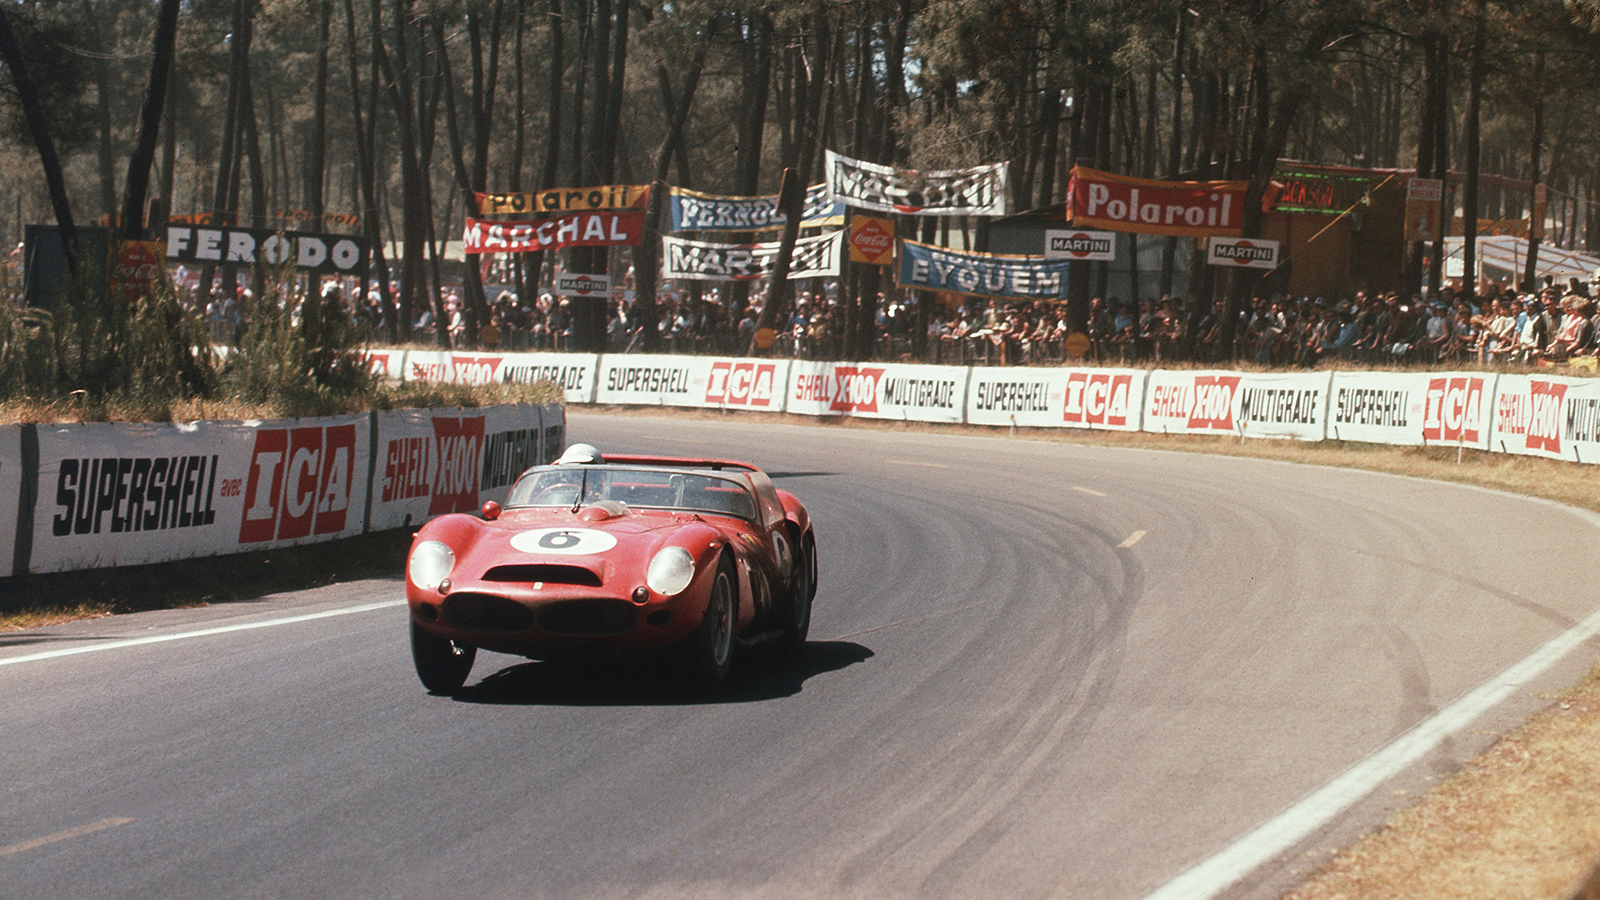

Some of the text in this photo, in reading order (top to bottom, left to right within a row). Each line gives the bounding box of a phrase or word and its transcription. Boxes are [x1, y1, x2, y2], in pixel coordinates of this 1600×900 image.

[1088, 183, 1232, 226] Polaroil
[166, 227, 360, 269] FERODO
[463, 215, 627, 249] MARCHAL
[1053, 239, 1109, 251] MARTINI
[1216, 246, 1271, 260] MARTINI
[561, 280, 606, 291] MARTINI
[912, 254, 1061, 294] EYQUEM
[607, 367, 773, 399] SUPERSHELL ICA
[796, 374, 955, 408] SHELL X-100 MULTIGRADE
[977, 381, 1127, 417] SUPERSHELL ICA
[1152, 384, 1318, 424] SHELL X-100 MULTIGRADE
[1336, 387, 1480, 431] SUPERSHELL ICA
[1498, 394, 1526, 434] SHELL
[1529, 393, 1560, 440] X-100
[382, 437, 430, 503] SHELL
[436, 435, 477, 496] X-100
[53, 446, 349, 536] SUPERSHELL avec ICA
[538, 531, 581, 549] 6
